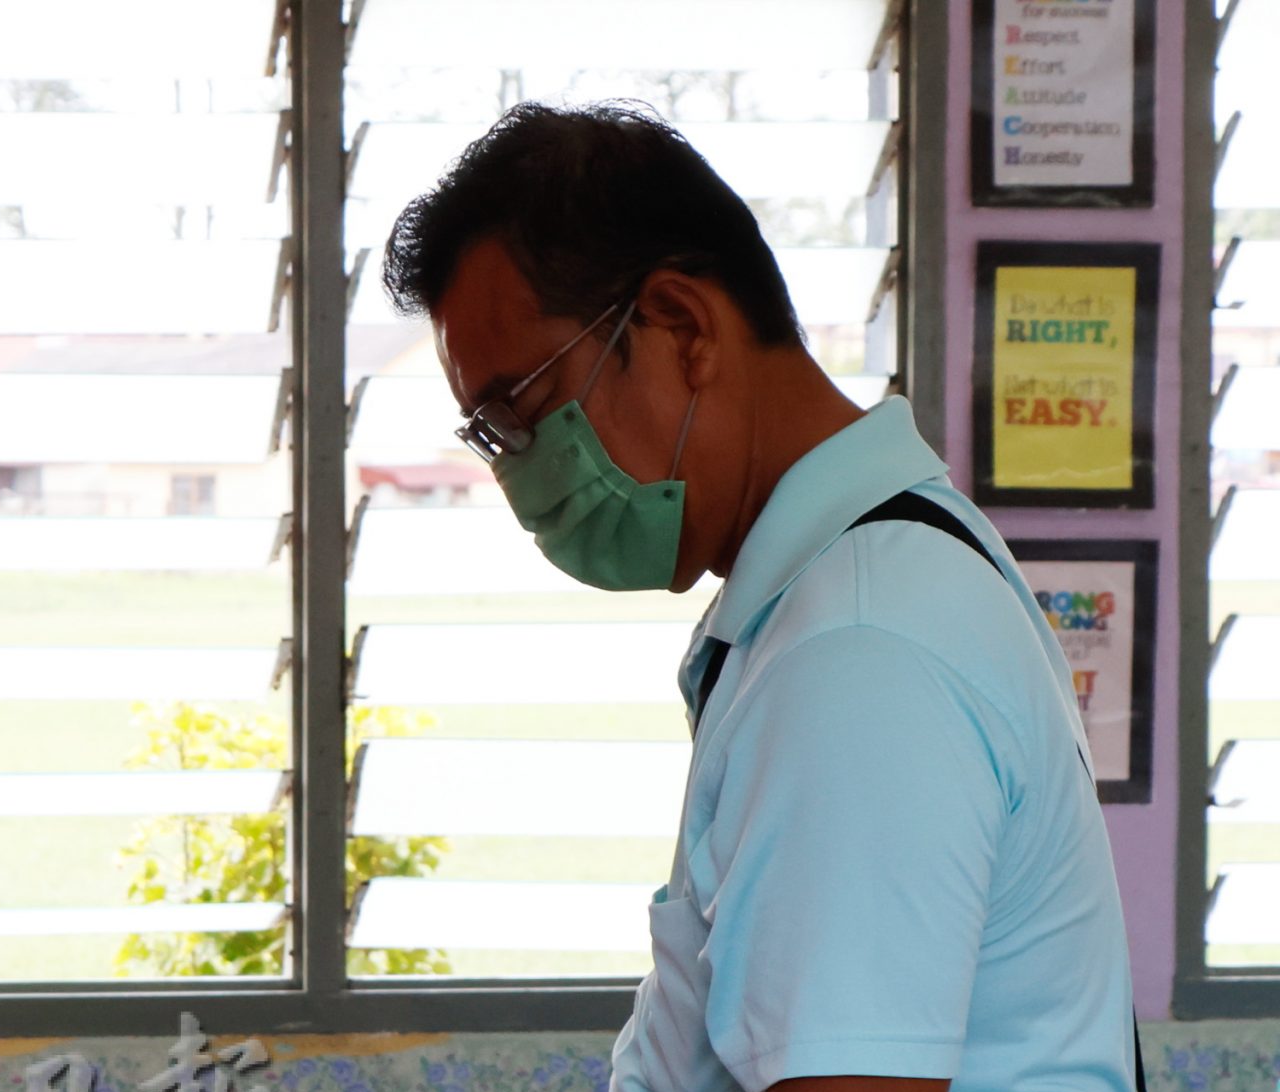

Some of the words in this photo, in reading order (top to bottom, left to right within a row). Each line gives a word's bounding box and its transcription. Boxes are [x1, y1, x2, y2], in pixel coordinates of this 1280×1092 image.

[1005, 25, 1081, 46] Respect
[1004, 55, 1066, 76] Effort
[1004, 86, 1088, 105] Attitude
[1002, 116, 1121, 138] Cooperation
[1004, 147, 1085, 167] Honesty
[1006, 319, 1118, 349] RIGHT,
[1004, 398, 1118, 427] EASY.
